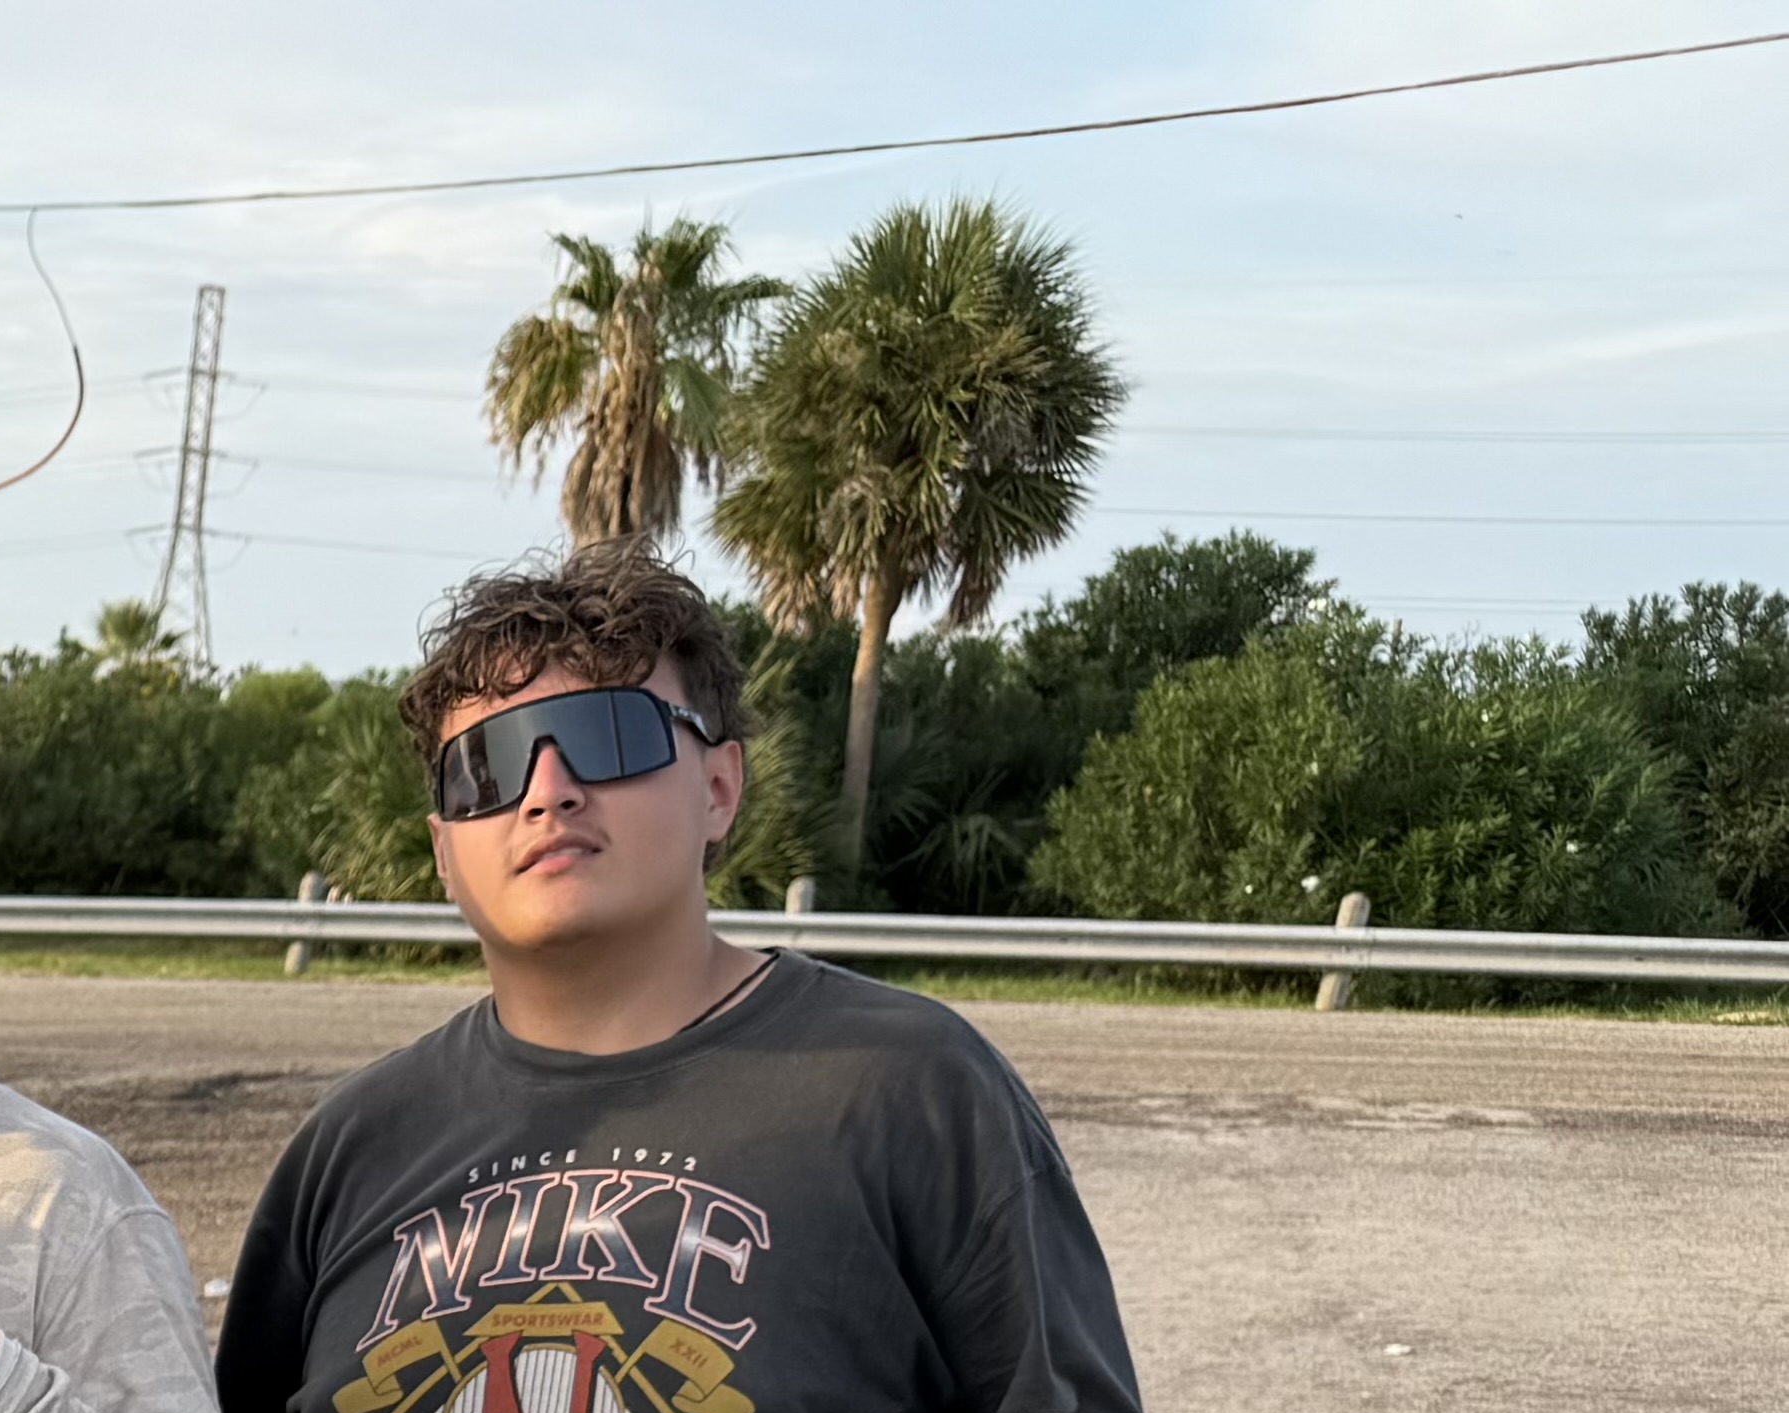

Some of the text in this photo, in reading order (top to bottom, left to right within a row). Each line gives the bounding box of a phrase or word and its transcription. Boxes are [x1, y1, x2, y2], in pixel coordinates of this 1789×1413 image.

[468, 1147, 697, 1184] SINCE 1972
[356, 1169, 770, 1352] NIKE
[491, 1312, 605, 1327] SPORTSWEAR
[668, 1337, 709, 1369] XXII
